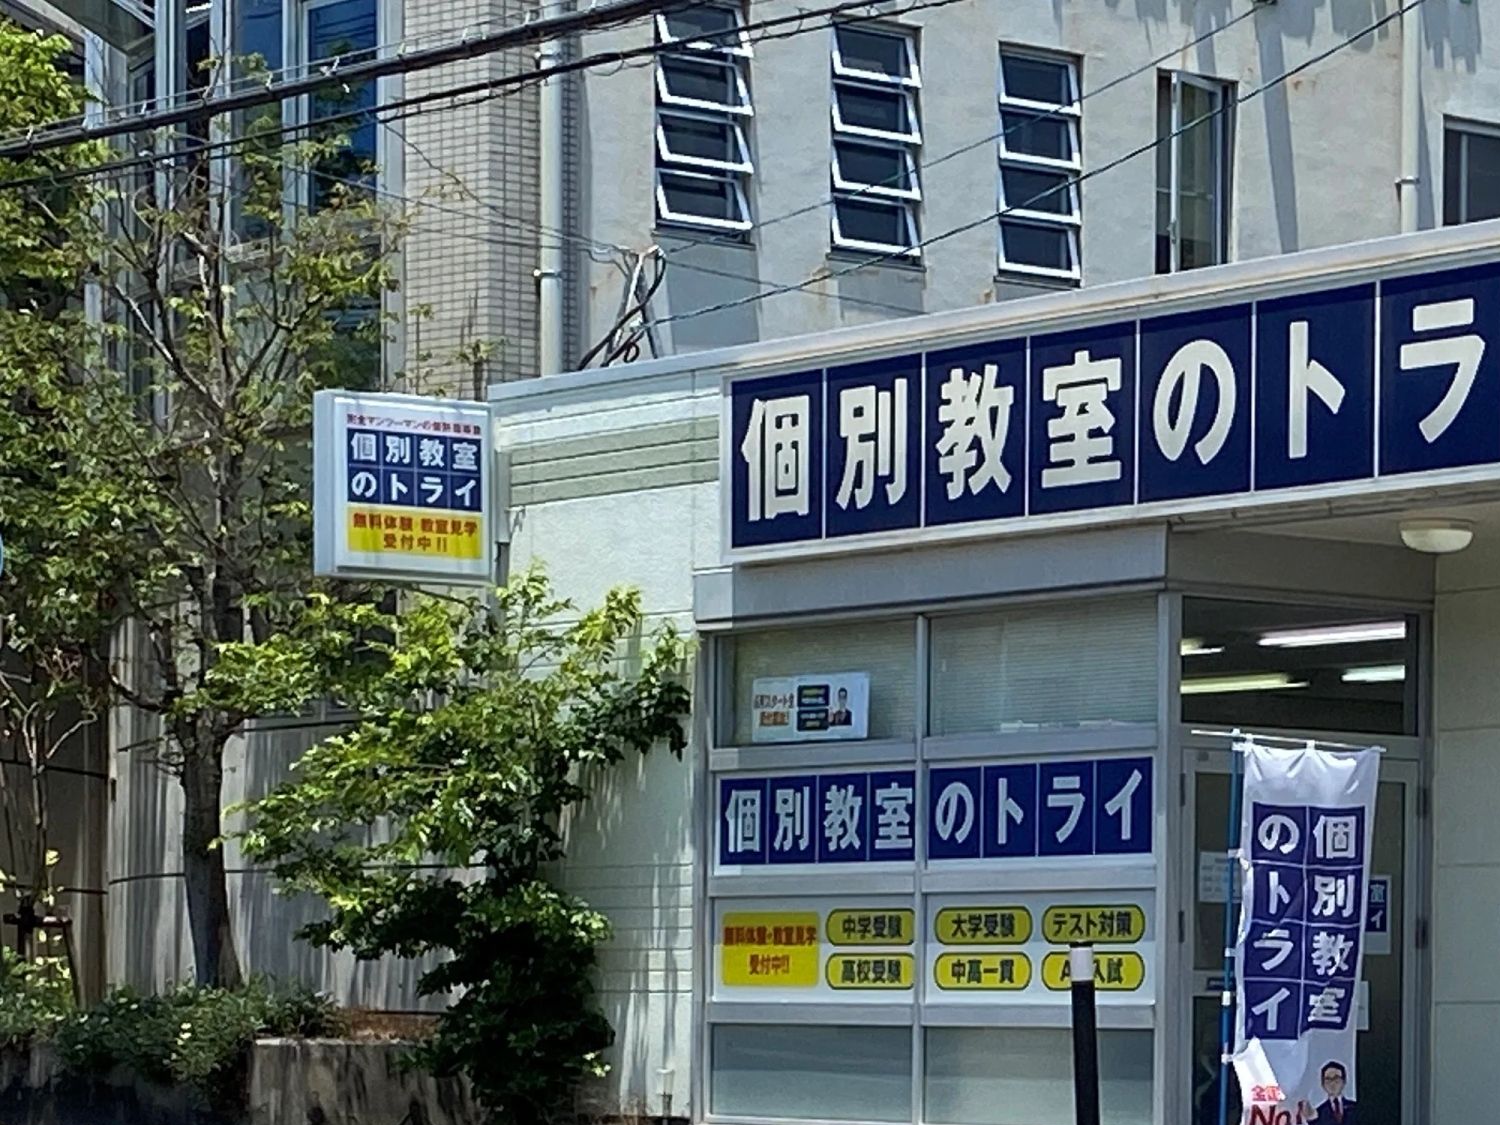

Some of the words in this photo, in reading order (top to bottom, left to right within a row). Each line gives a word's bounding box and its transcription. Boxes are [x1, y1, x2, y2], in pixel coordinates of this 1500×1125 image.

[350, 432, 478, 471] 個別教室
[351, 471, 476, 506] のトライ
[725, 769, 1143, 854] 個別教室のトライ
[842, 914, 903, 940] 中学受験
[951, 912, 1016, 938] 大学受験
[1052, 911, 1132, 938] テスト対策
[1250, 814, 1299, 1031] のトライ
[1307, 814, 1357, 1023] 個別教室
[841, 959, 903, 984] 高校受験
[951, 959, 1015, 984] 中高一貫
[1060, 958, 1124, 984] A入試
